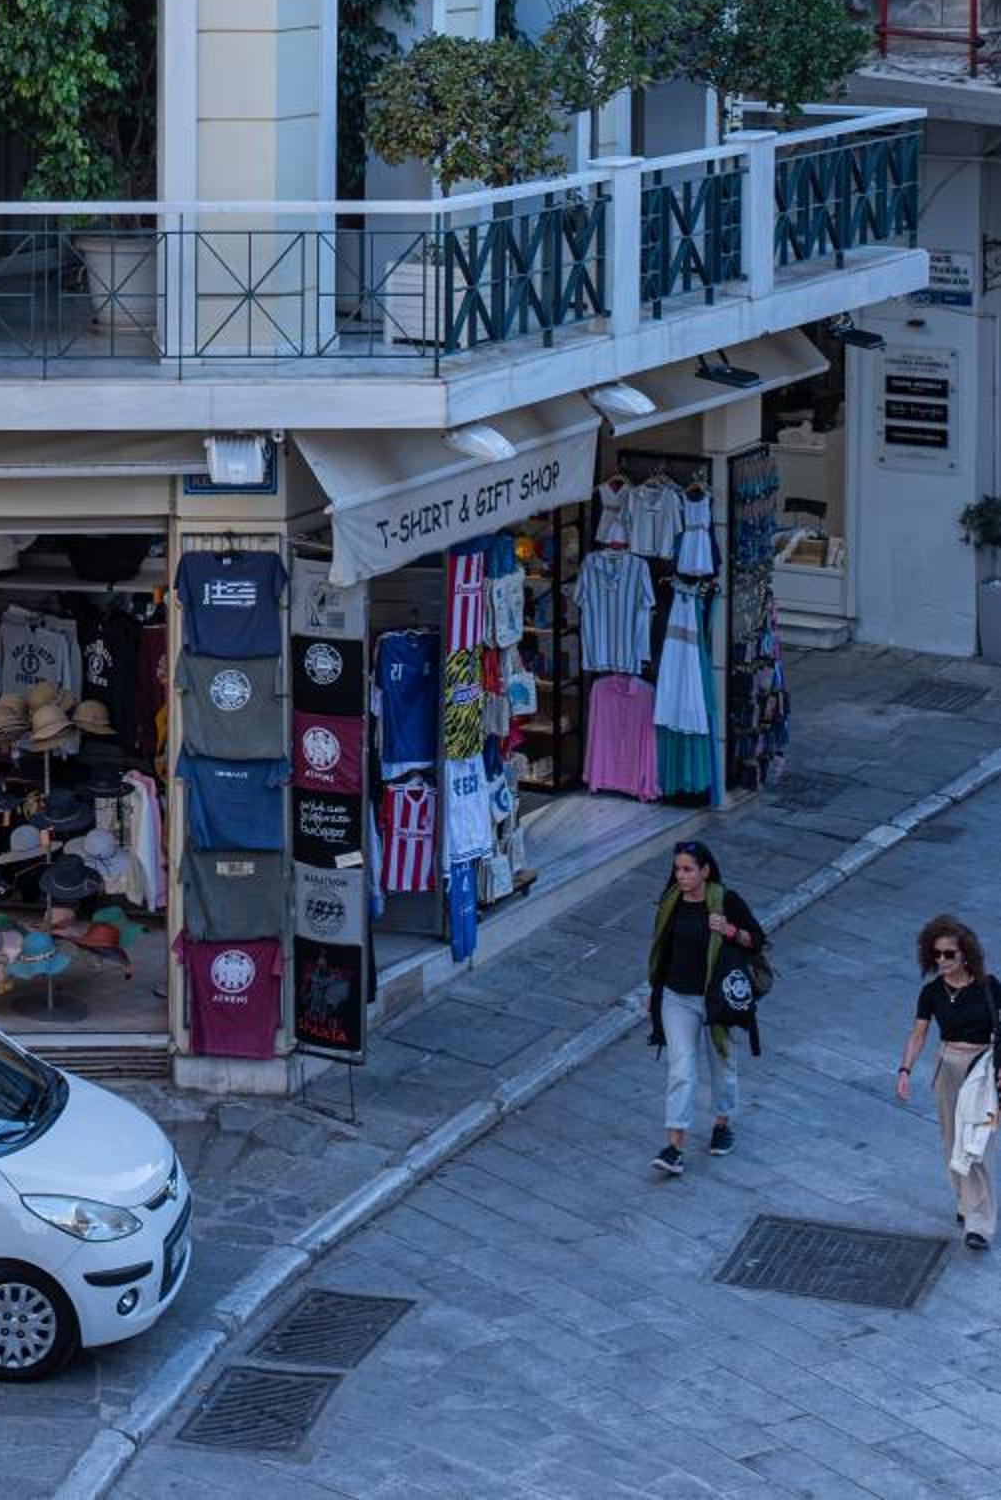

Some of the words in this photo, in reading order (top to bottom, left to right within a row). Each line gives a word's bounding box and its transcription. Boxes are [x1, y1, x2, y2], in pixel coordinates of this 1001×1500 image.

[376, 499, 455, 549] T-SHIRT
[458, 494, 471, 524] &
[475, 477, 516, 519] GIFT
[520, 460, 560, 501] SHOP
